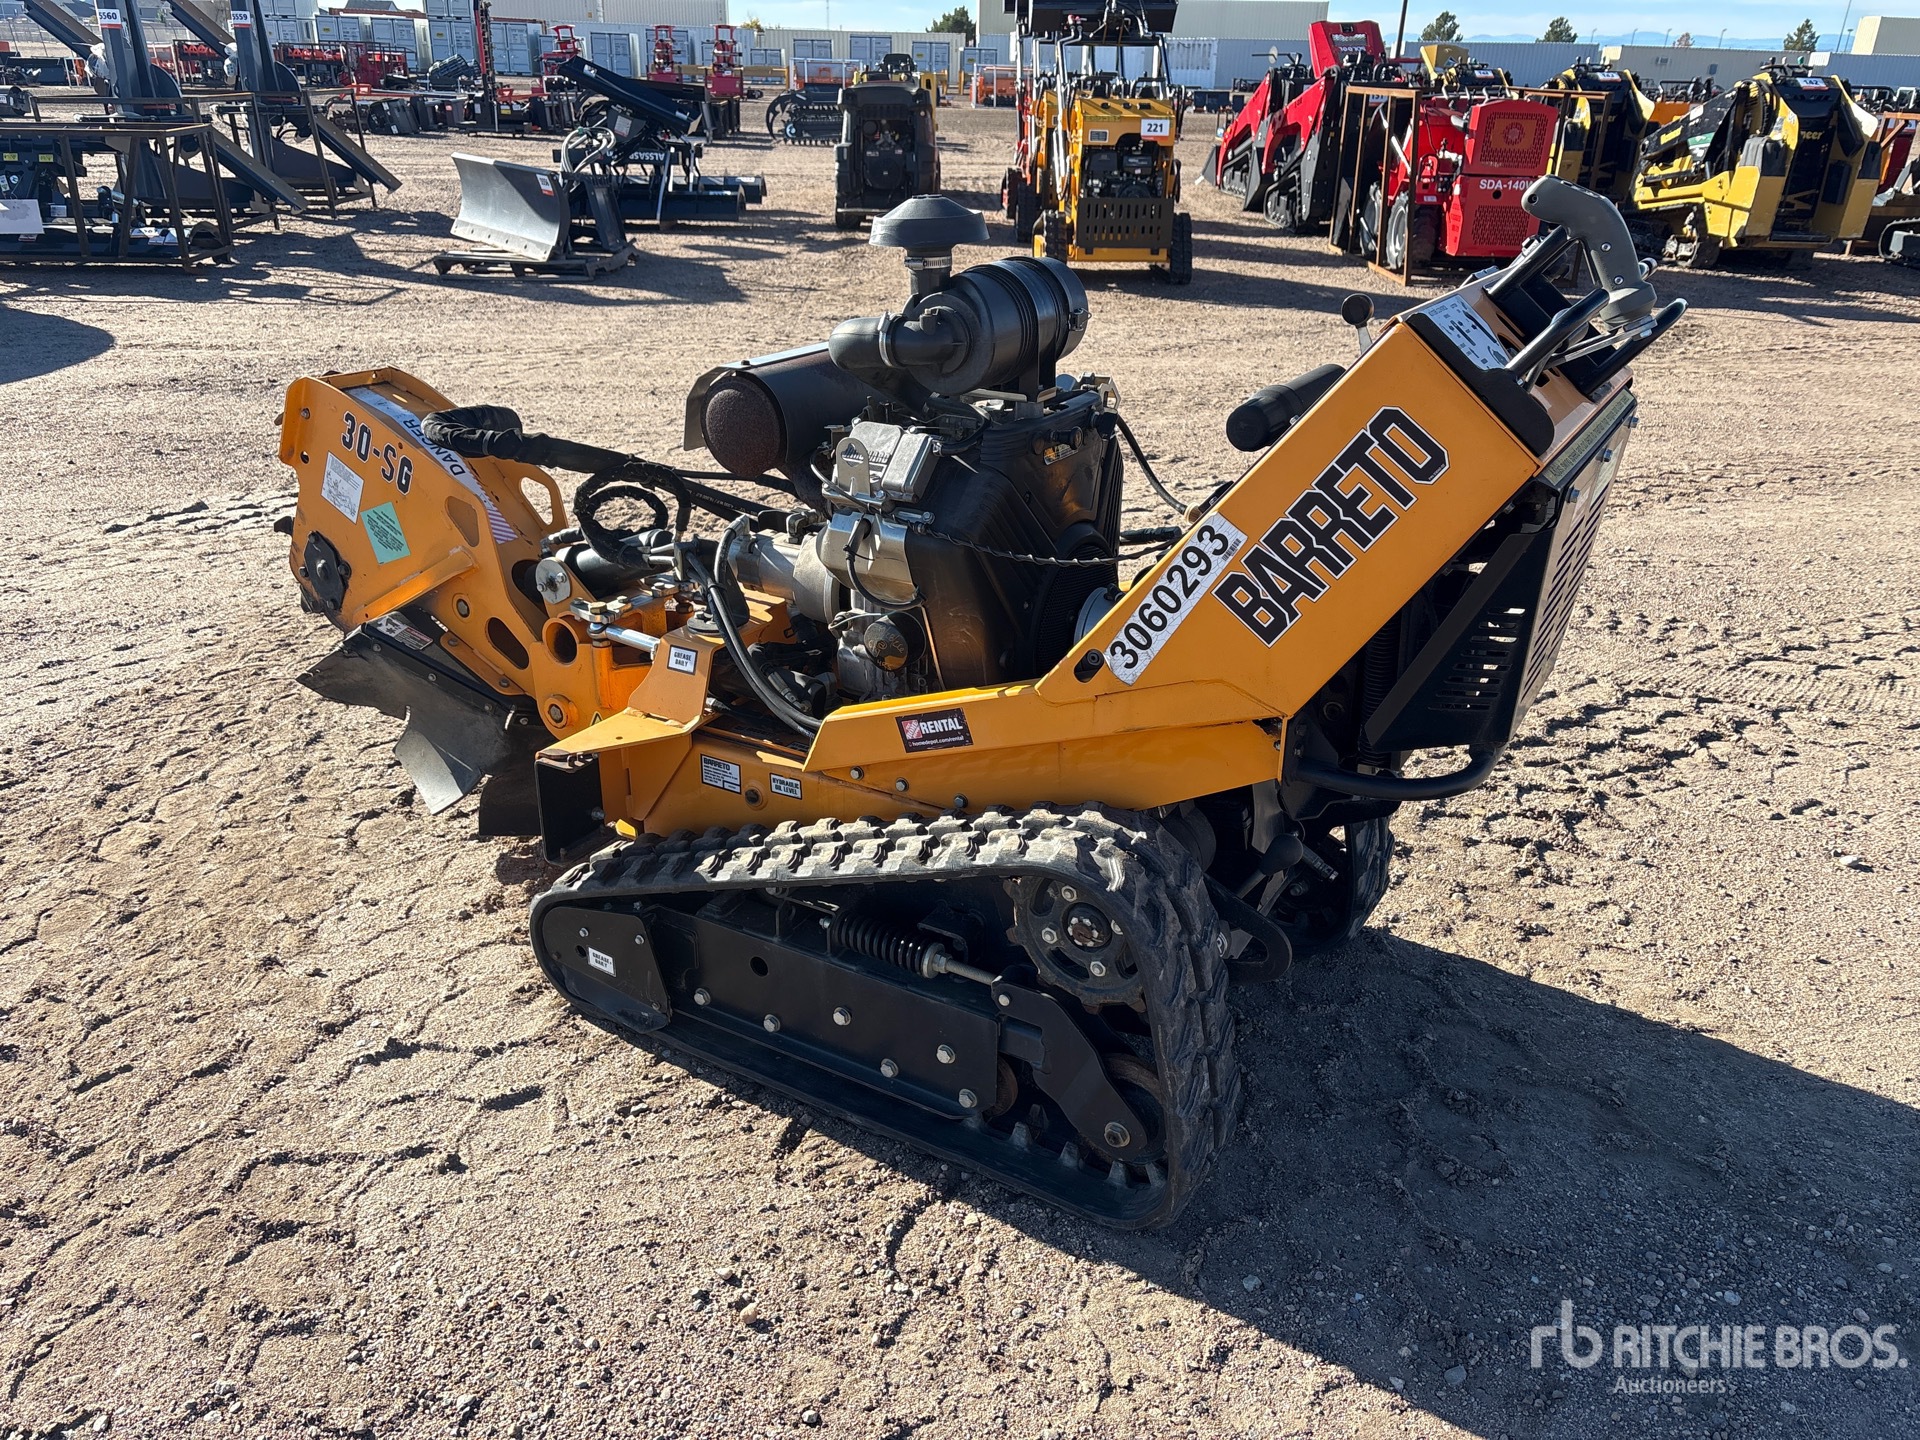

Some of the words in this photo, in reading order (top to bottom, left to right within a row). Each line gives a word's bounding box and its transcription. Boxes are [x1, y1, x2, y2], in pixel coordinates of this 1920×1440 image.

[1147, 123, 1163, 133] 221
[341, 411, 413, 495] 30-SG
[1210, 405, 1450, 648] BARRETO
[1109, 524, 1229, 669] 3060293
[674, 652, 691, 661] GREASE
[675, 659, 688, 667] DAILY
[920, 717, 963, 734] RENTAL
[772, 777, 799, 789] HYDRAULIC
[783, 786, 797, 795] LEVEL
